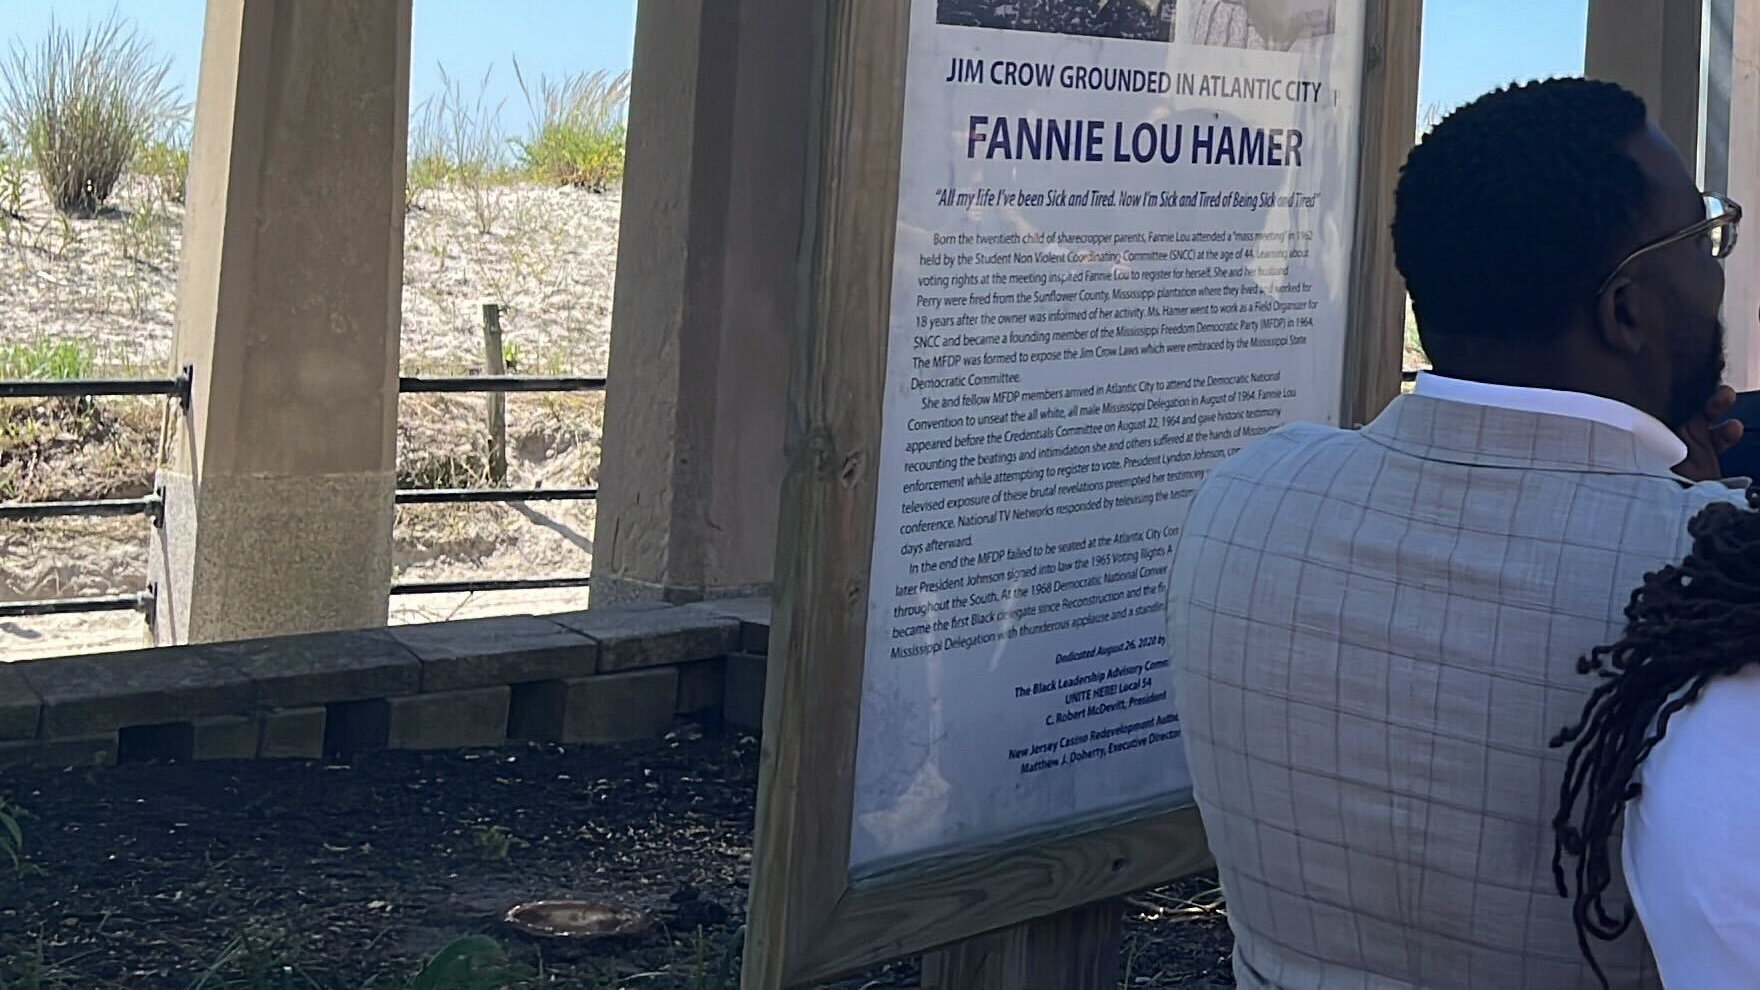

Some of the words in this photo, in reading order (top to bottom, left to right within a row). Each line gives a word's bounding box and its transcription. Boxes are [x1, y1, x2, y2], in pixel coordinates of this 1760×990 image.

[946, 58, 984, 83] JIM
[990, 61, 1054, 87] CROW
[1060, 66, 1171, 94] GROUNDED
[1176, 73, 1194, 96] IN
[1199, 74, 1282, 101] ATLANTIC
[1286, 81, 1322, 102] CITY
[968, 116, 1104, 162] FANNIE
[1114, 122, 1182, 164] LOU
[1192, 125, 1302, 166] HAMER
[957, 195, 974, 210] my
[976, 190, 994, 206] life
[1018, 190, 1043, 206] been
[1046, 190, 1066, 206] Sick
[1069, 190, 1088, 206] and
[1091, 191, 1115, 207] Tired.
[1119, 191, 1140, 207] Now
[1160, 191, 1177, 207] Sick
[1180, 192, 1197, 207] and
[1199, 192, 1220, 207] Tired
[1222, 191, 1233, 208] of
[1232, 192, 1258, 212] Being
[1259, 192, 1276, 208] Sick
[911, 376, 966, 389] Democratic
[958, 511, 997, 526] National
[997, 511, 1011, 522] TV
[1012, 505, 1055, 520] Networks
[1103, 498, 1114, 509] by
[1155, 491, 1168, 500] the
[901, 544, 924, 556] days
[1055, 647, 1096, 664] Dedicated
[1097, 644, 1124, 657] August
[1015, 686, 1031, 698] The
[1033, 681, 1057, 694] Black
[1058, 671, 1106, 690] Leadership
[1107, 664, 1143, 679] Advisory
[1065, 690, 1092, 704] UNITE
[1119, 680, 1141, 693] Local
[1142, 678, 1152, 688] 54
[1056, 708, 1085, 723] Robert
[1128, 691, 1167, 708] President
[1008, 749, 1028, 759] New
[1029, 740, 1059, 756] Jersey
[1060, 734, 1088, 748] Casino
[1090, 718, 1154, 741] Redevelopment
[1020, 758, 1059, 774] Matthew
[1108, 738, 1147, 754] Executive
[1148, 729, 1181, 743] Director
